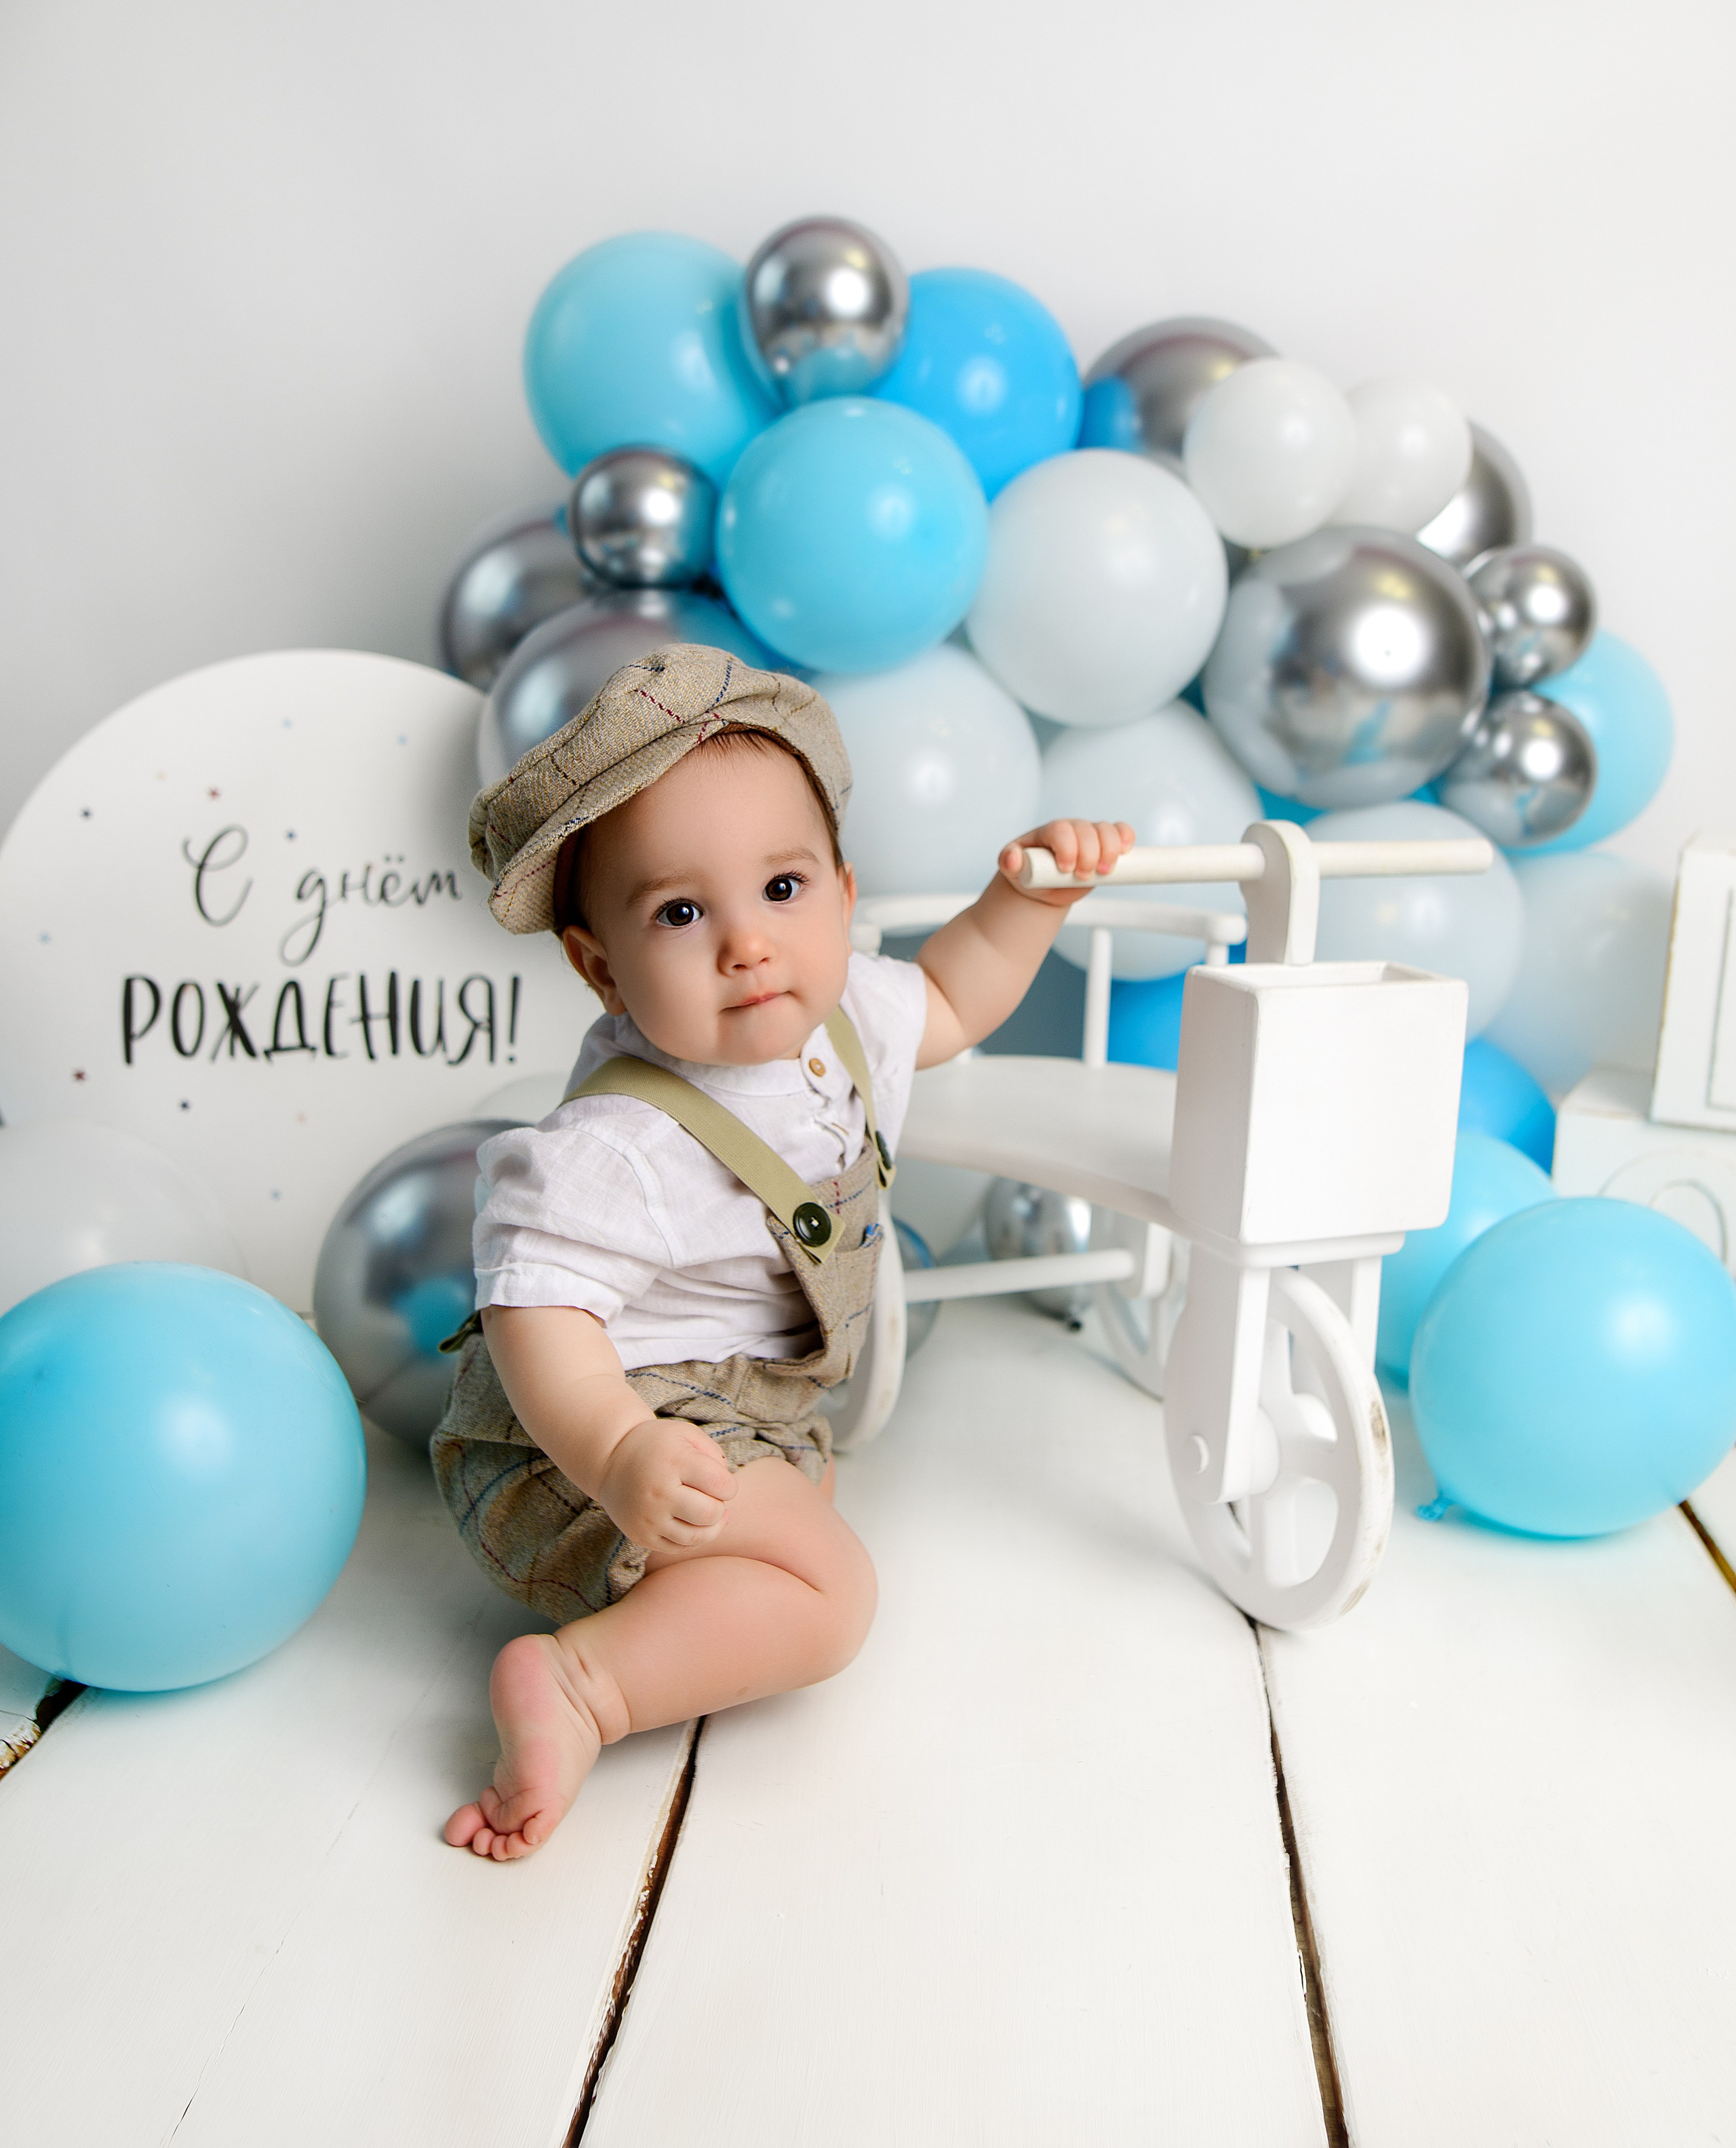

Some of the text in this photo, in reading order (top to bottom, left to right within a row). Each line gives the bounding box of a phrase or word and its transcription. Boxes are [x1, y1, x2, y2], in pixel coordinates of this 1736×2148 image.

[182, 824, 462, 967] С днём
[120, 969, 522, 1068] РОЖДЕНИЯ!
